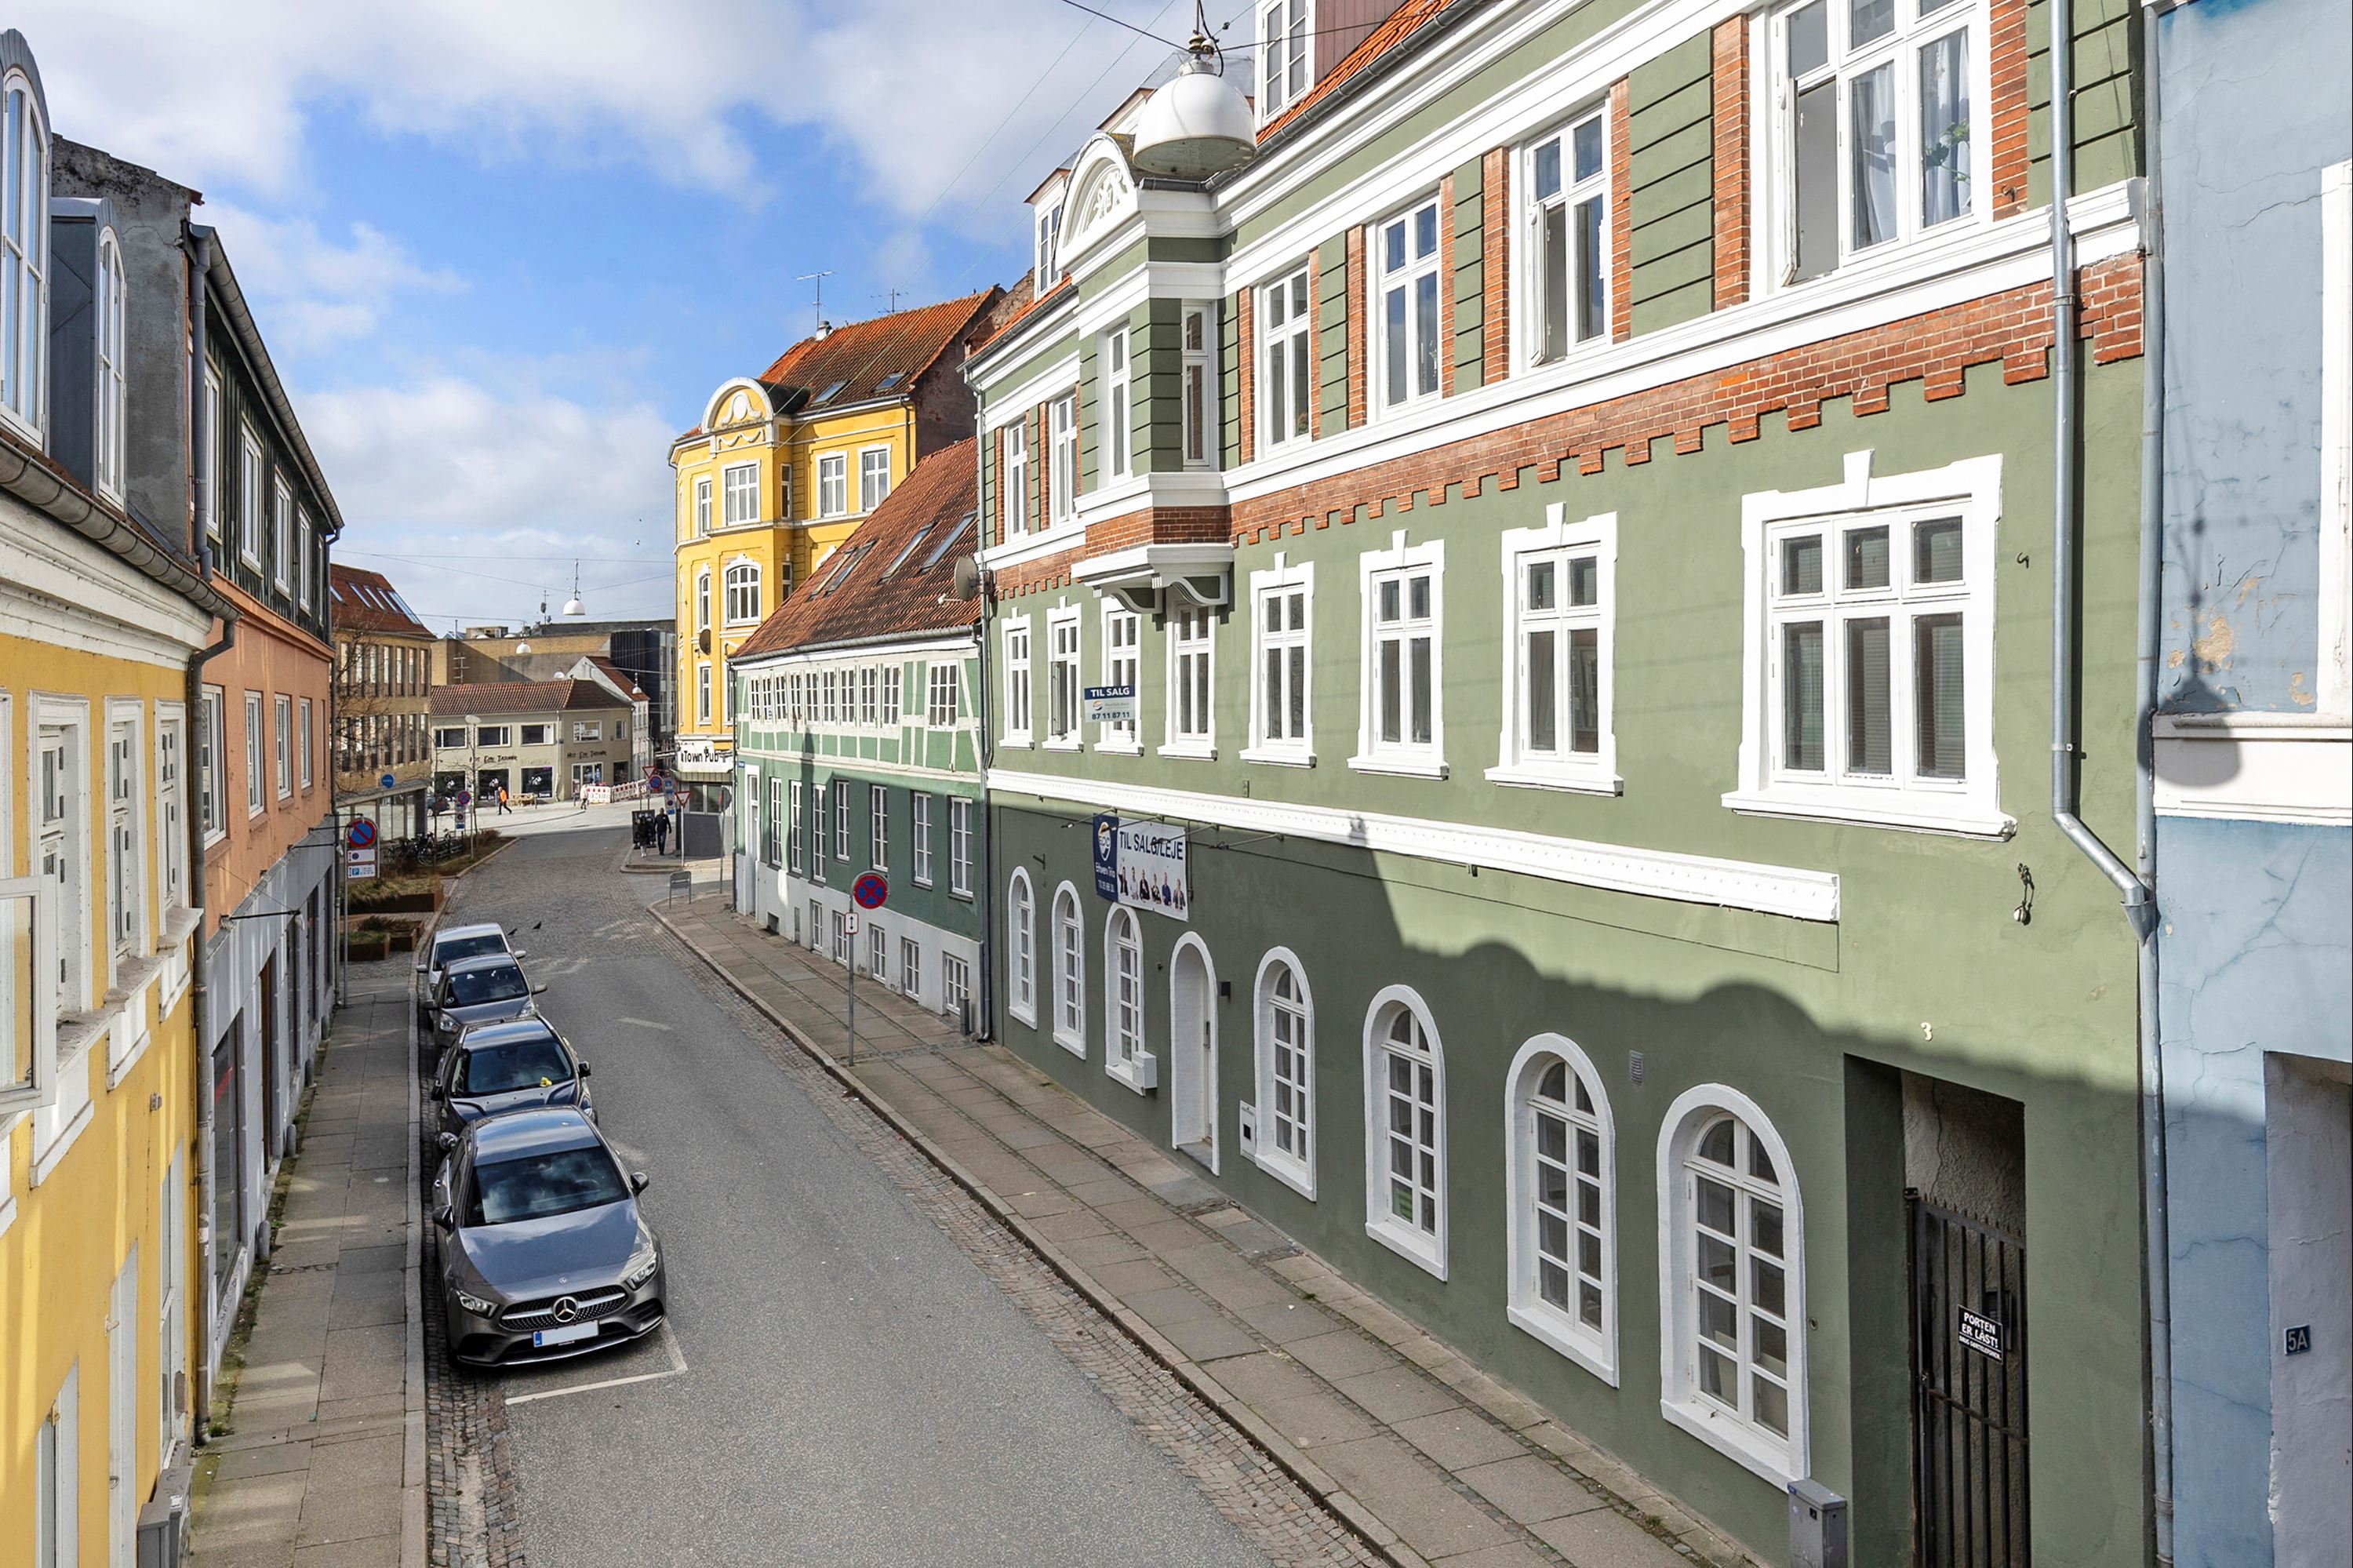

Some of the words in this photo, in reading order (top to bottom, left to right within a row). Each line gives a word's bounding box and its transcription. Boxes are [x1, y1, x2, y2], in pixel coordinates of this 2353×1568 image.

[1090, 689, 1105, 697] TIL
[1106, 687, 1130, 696] SALG
[1119, 831, 1132, 849] TIL
[1920, 1022, 1933, 1042] 3
[1964, 1312, 1996, 1335] PORTEN
[1962, 1323, 1973, 1336] ER
[1975, 1330, 1998, 1348] LÅST!
[2288, 1330, 2308, 1351] 5A
